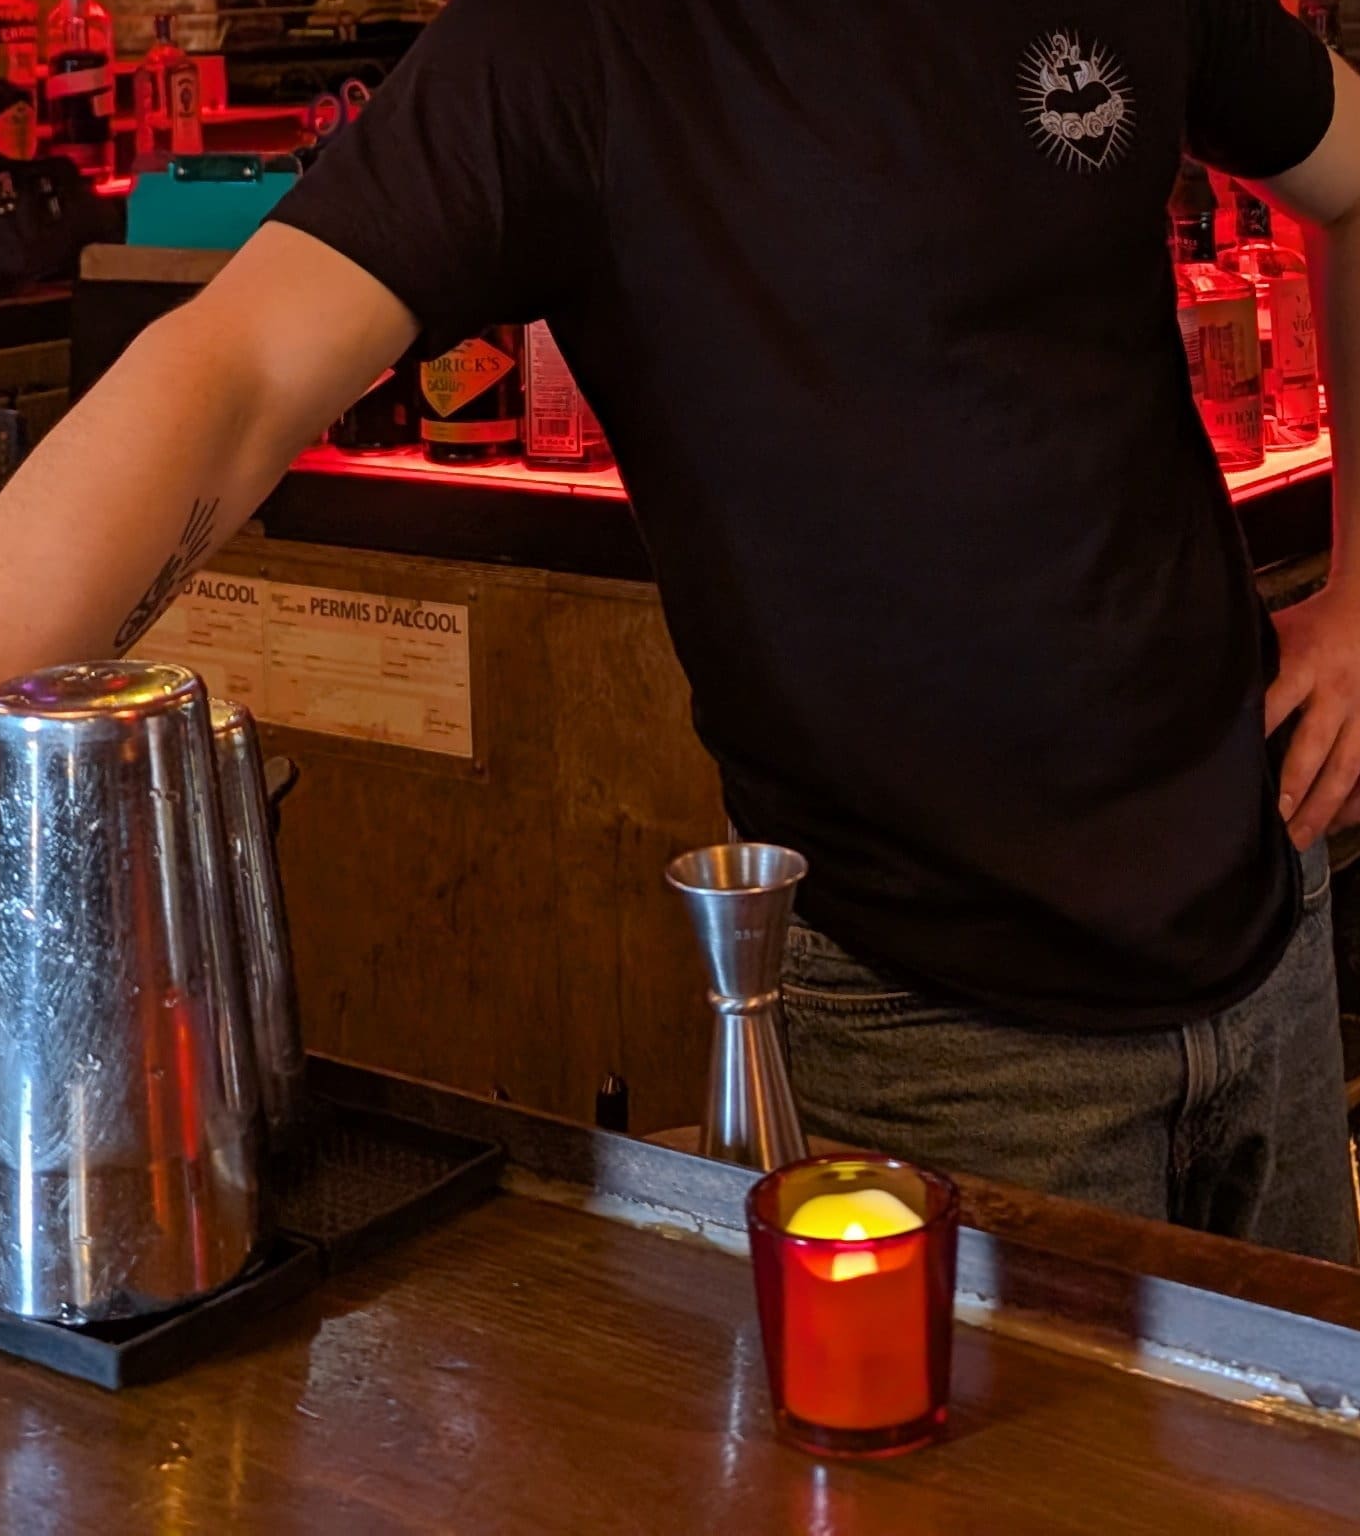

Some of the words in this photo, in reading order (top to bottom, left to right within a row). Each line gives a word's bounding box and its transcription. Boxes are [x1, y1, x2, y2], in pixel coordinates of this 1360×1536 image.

[427, 356, 501, 373] DRICK'S
[310, 596, 371, 623] PERMIS
[375, 605, 461, 634] D'ALCOOL
